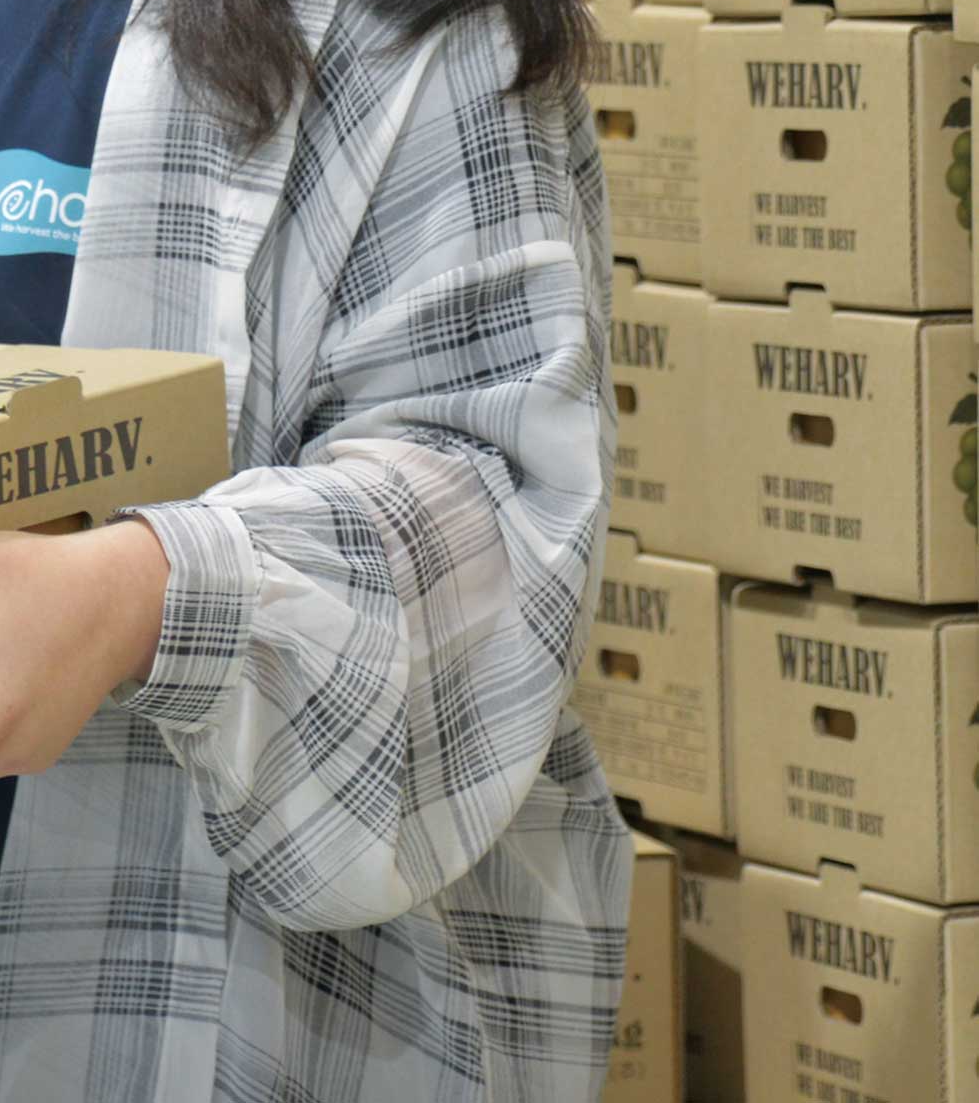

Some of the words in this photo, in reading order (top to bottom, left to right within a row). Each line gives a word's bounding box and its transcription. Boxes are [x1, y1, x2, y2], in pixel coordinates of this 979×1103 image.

[746, 61, 867, 110] WEHARV.
[752, 342, 873, 401] WEHARV.
[597, 580, 675, 635] HARV.
[776, 632, 893, 699] WEHARV.
[784, 909, 901, 986] WEHARV.
